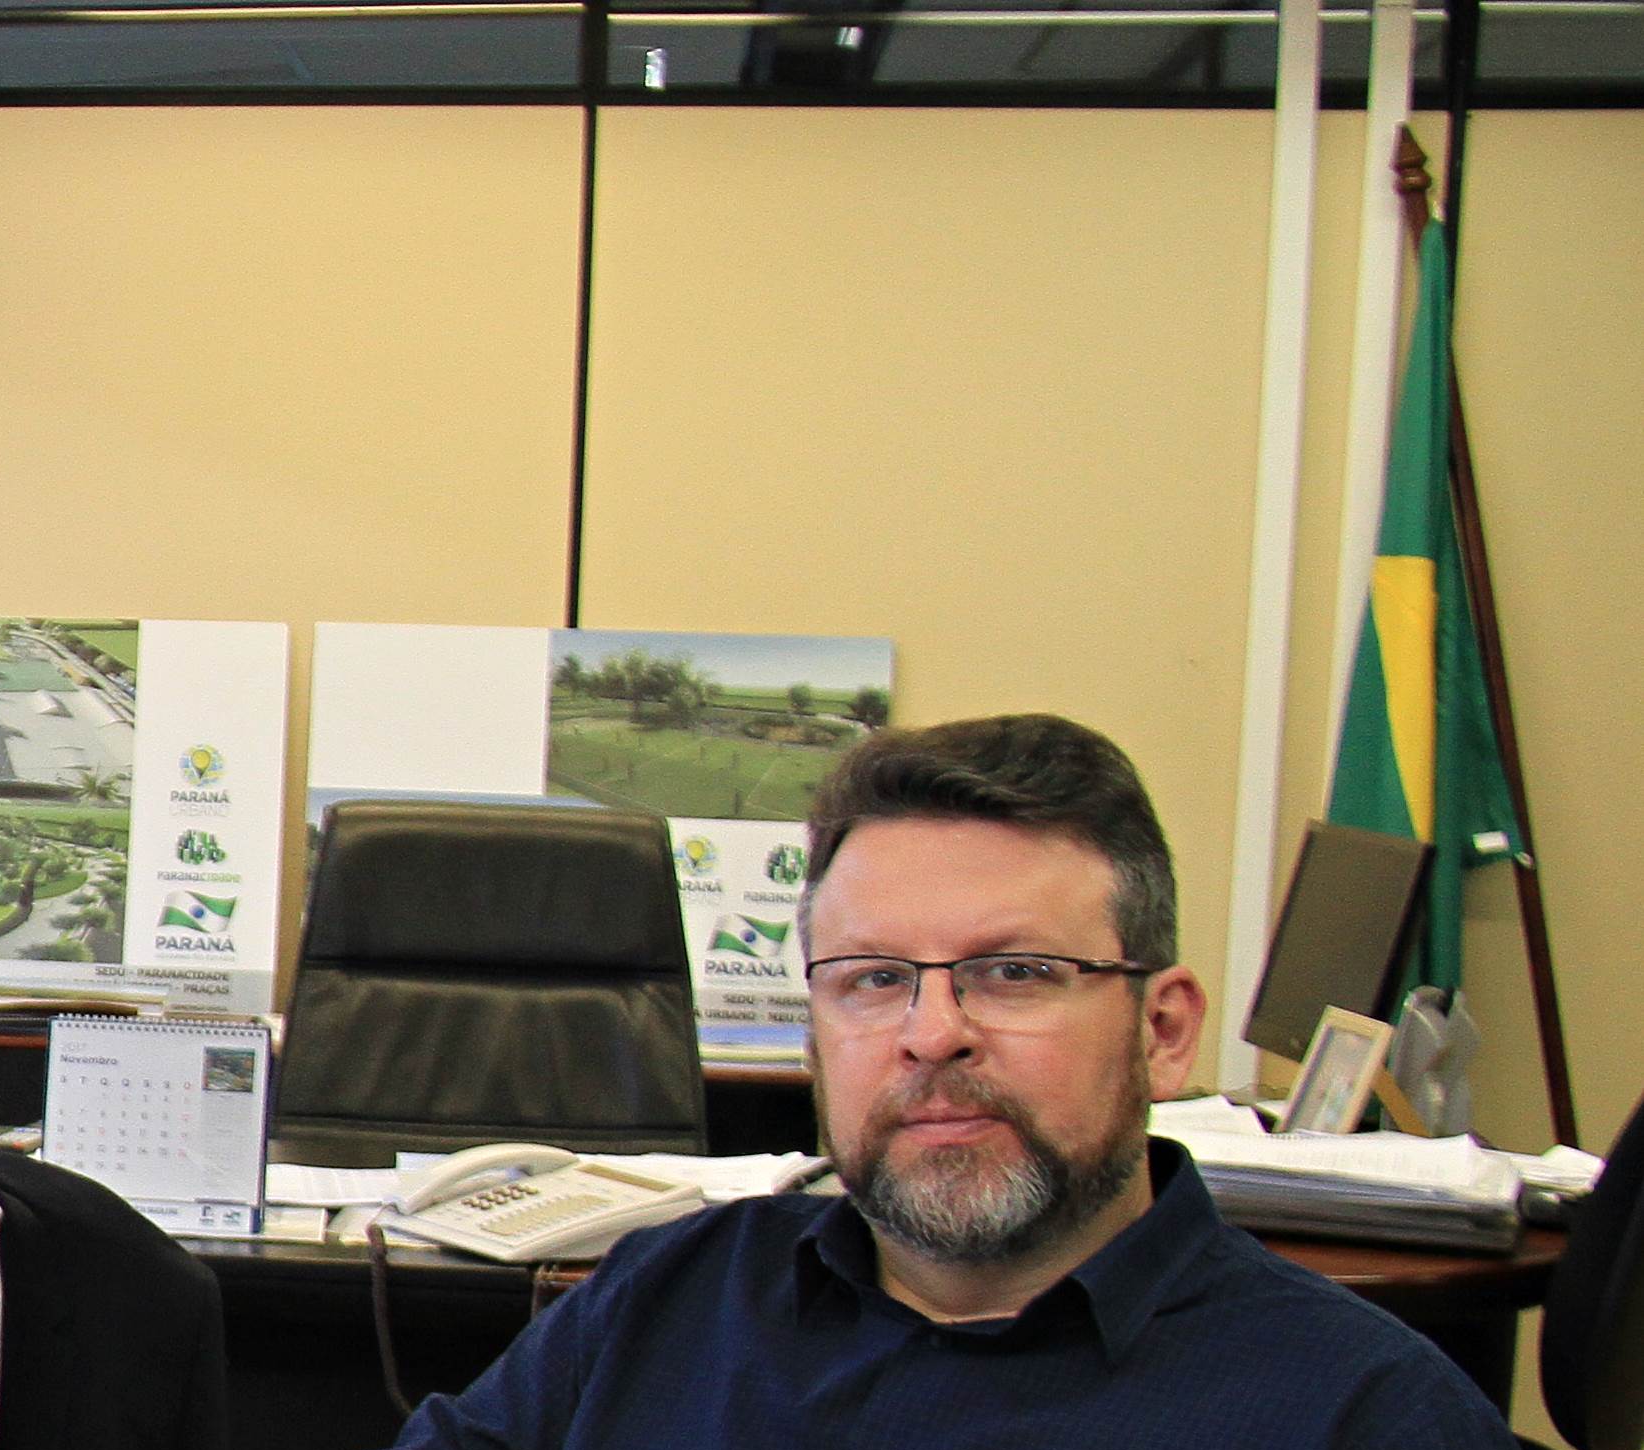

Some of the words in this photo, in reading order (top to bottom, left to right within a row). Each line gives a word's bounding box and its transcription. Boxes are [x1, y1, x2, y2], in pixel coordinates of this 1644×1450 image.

[170, 790, 231, 804] PARANÁ
[155, 933, 236, 953] PARANÁ
[95, 966, 125, 977] SEDU
[137, 968, 230, 981] PARANACIDADE
[183, 982, 230, 995] PRAÇAS
[60, 1053, 118, 1066] Novembro
